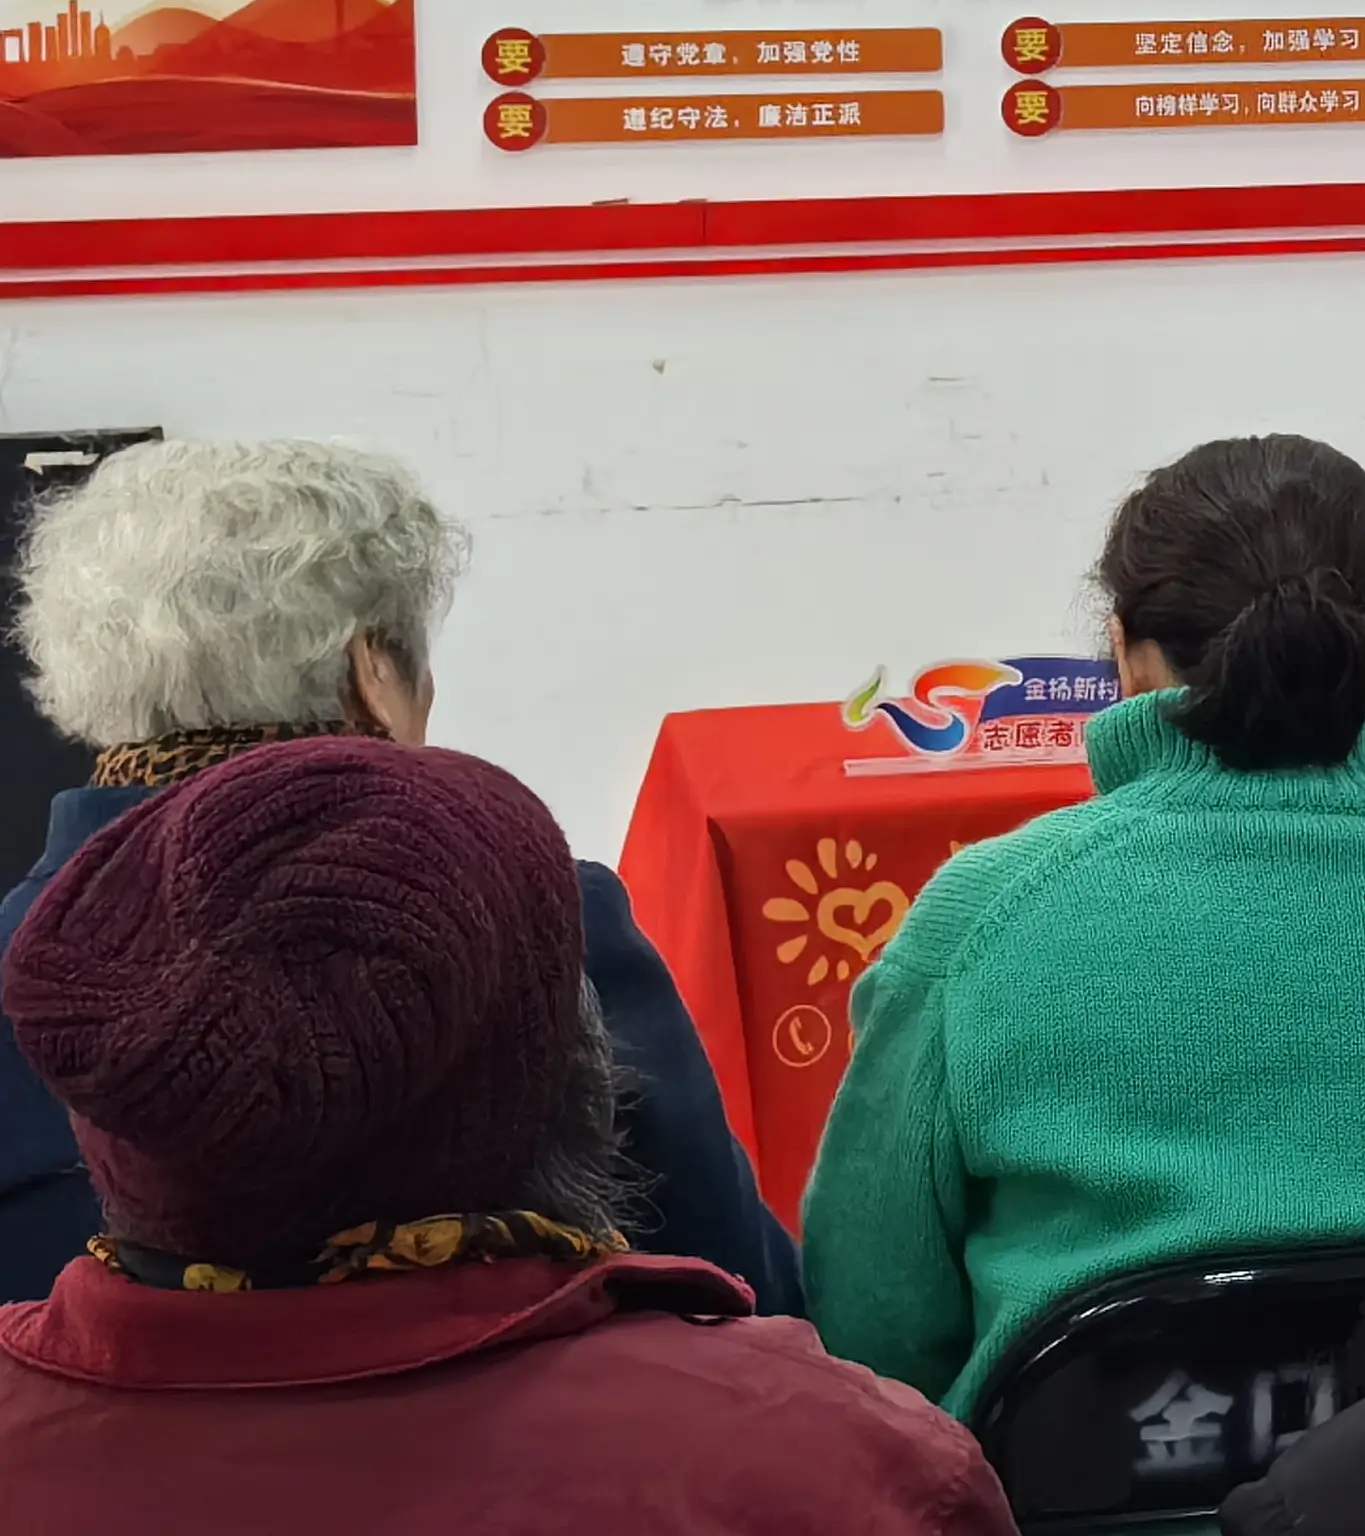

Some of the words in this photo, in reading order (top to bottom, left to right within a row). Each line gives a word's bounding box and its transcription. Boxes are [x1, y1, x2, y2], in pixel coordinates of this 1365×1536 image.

[494, 38, 532, 75] 要
[1013, 28, 1048, 63] 要
[496, 103, 534, 139] 要
[1014, 90, 1049, 125] 要
[1023, 675, 1119, 702] 金杨新村
[984, 720, 1083, 751] 志愿者
